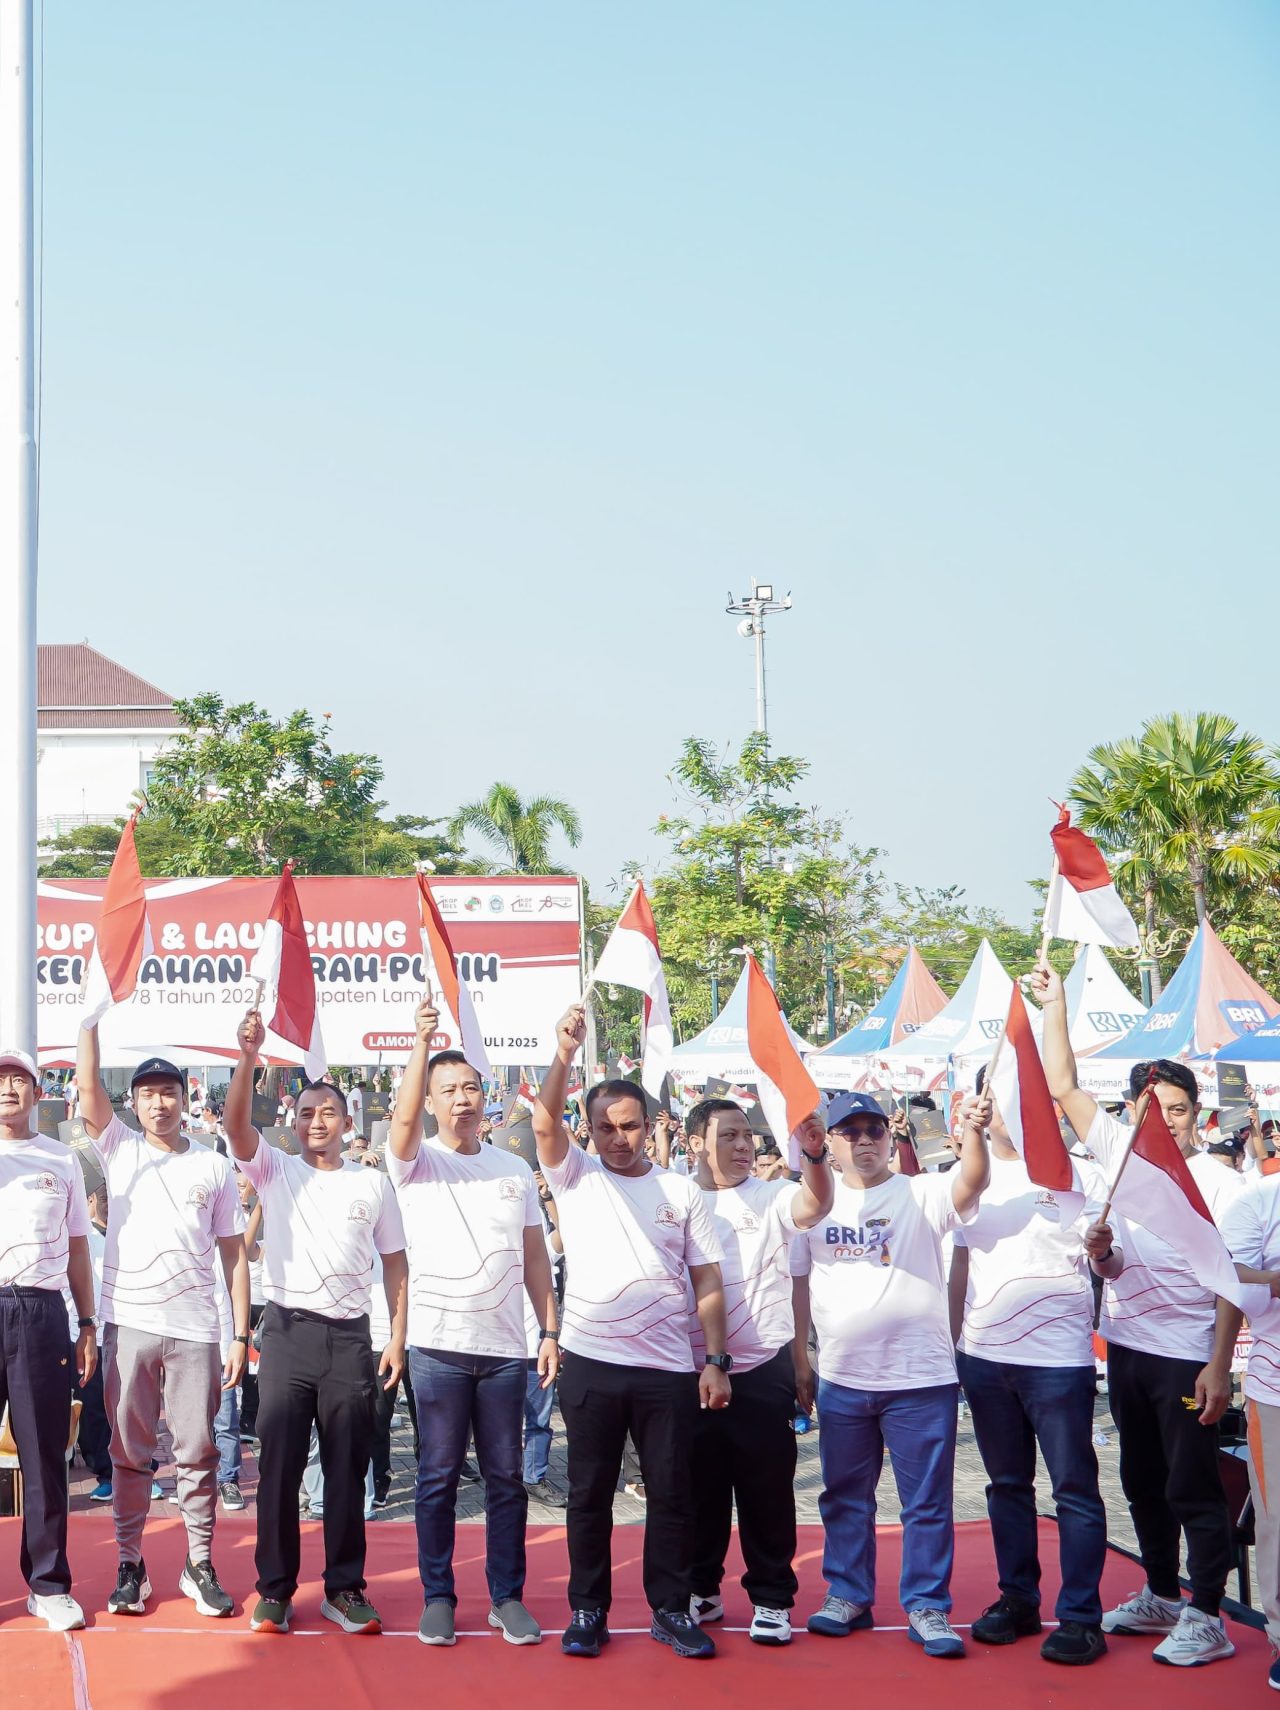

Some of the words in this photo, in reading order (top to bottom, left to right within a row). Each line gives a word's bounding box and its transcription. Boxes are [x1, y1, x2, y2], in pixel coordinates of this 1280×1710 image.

[160, 922, 186, 950] &
[194, 920, 407, 950] LAUHING
[37, 957, 242, 985] KELAHAN
[310, 956, 379, 983] RAH
[389, 956, 497, 983] PUIH
[157, 989, 215, 1004] Tahun
[272, 987, 376, 1008] Kupaten
[382, 988, 484, 1004] Lamonn
[1227, 1007, 1266, 1023] BRI
[369, 1036, 446, 1047] LAMONAN
[484, 1037, 504, 1047] ULI
[507, 1037, 539, 1047] 2025
[826, 1226, 864, 1245] BRI
